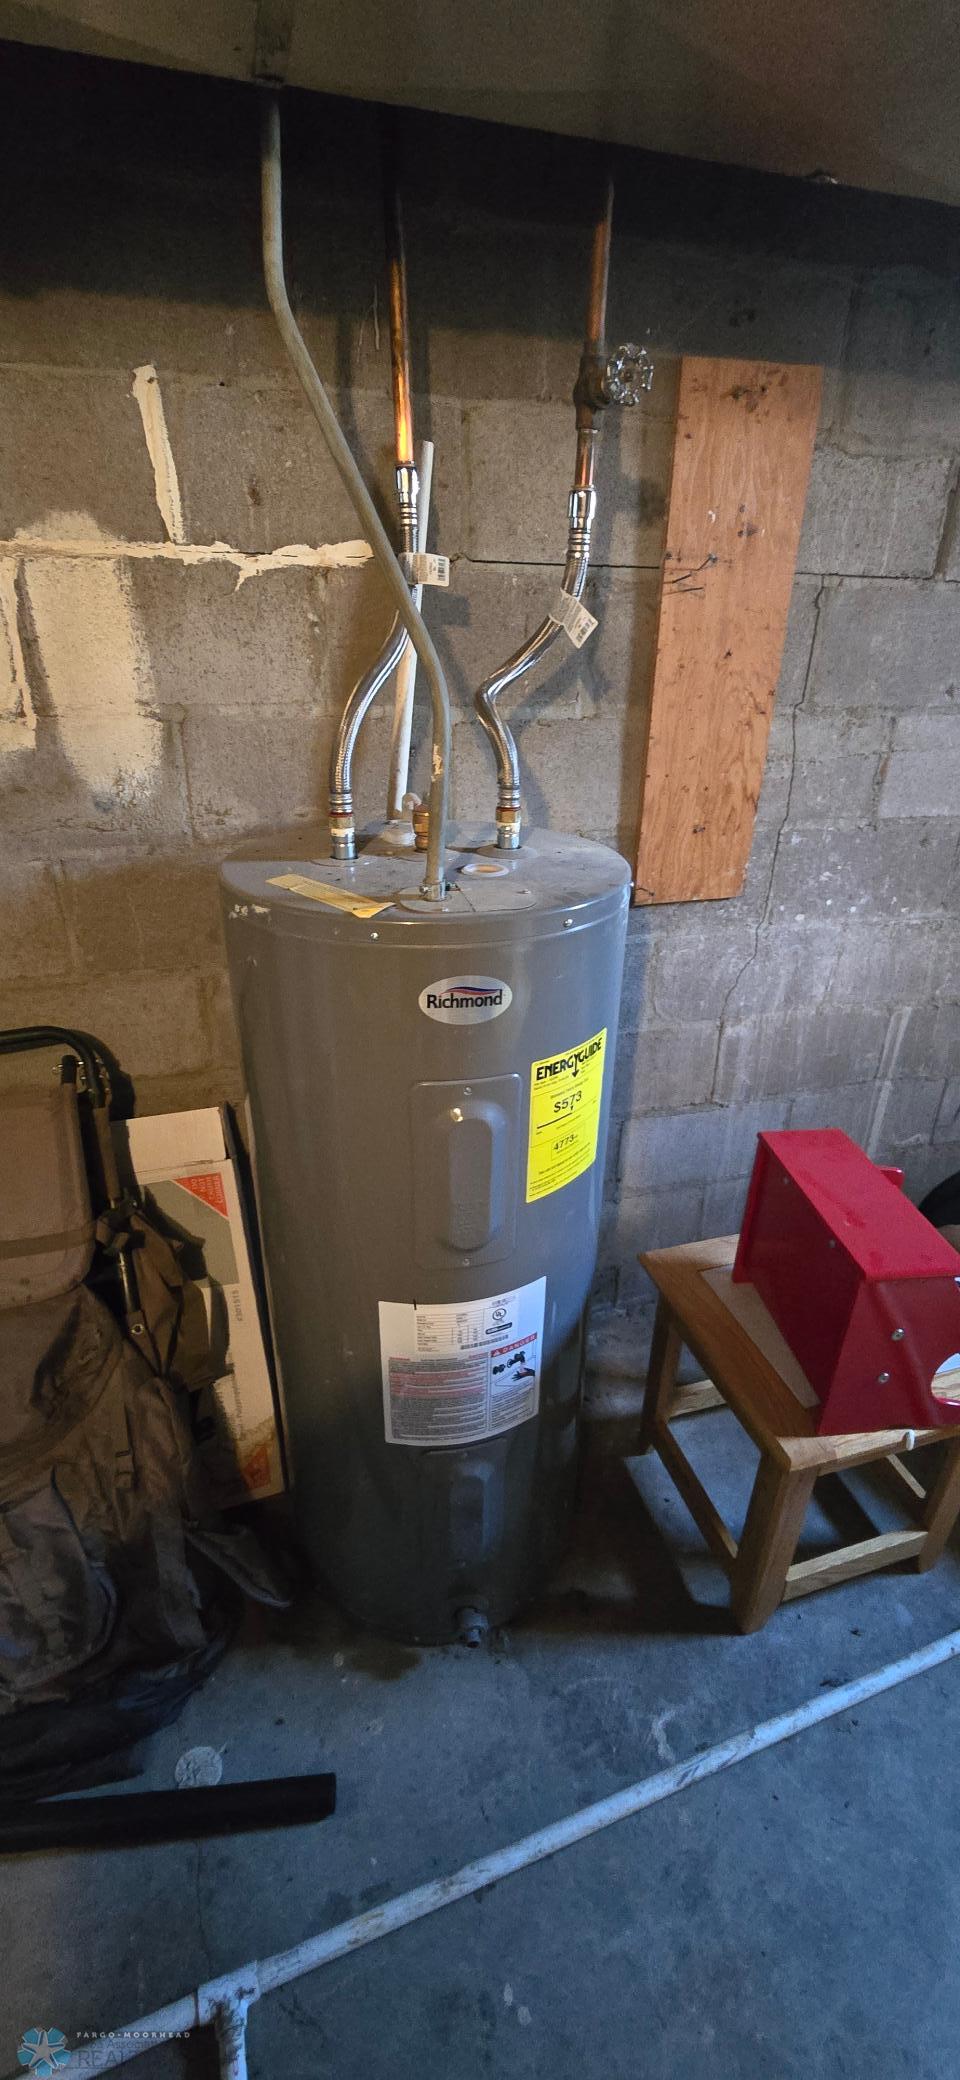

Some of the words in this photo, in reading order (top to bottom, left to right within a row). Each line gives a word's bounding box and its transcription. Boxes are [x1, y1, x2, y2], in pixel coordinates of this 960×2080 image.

[427, 989, 502, 1008] Richmond
[536, 1037, 602, 1080] ENERGYGUIDE
[502, 1335, 536, 1352] DANGER
